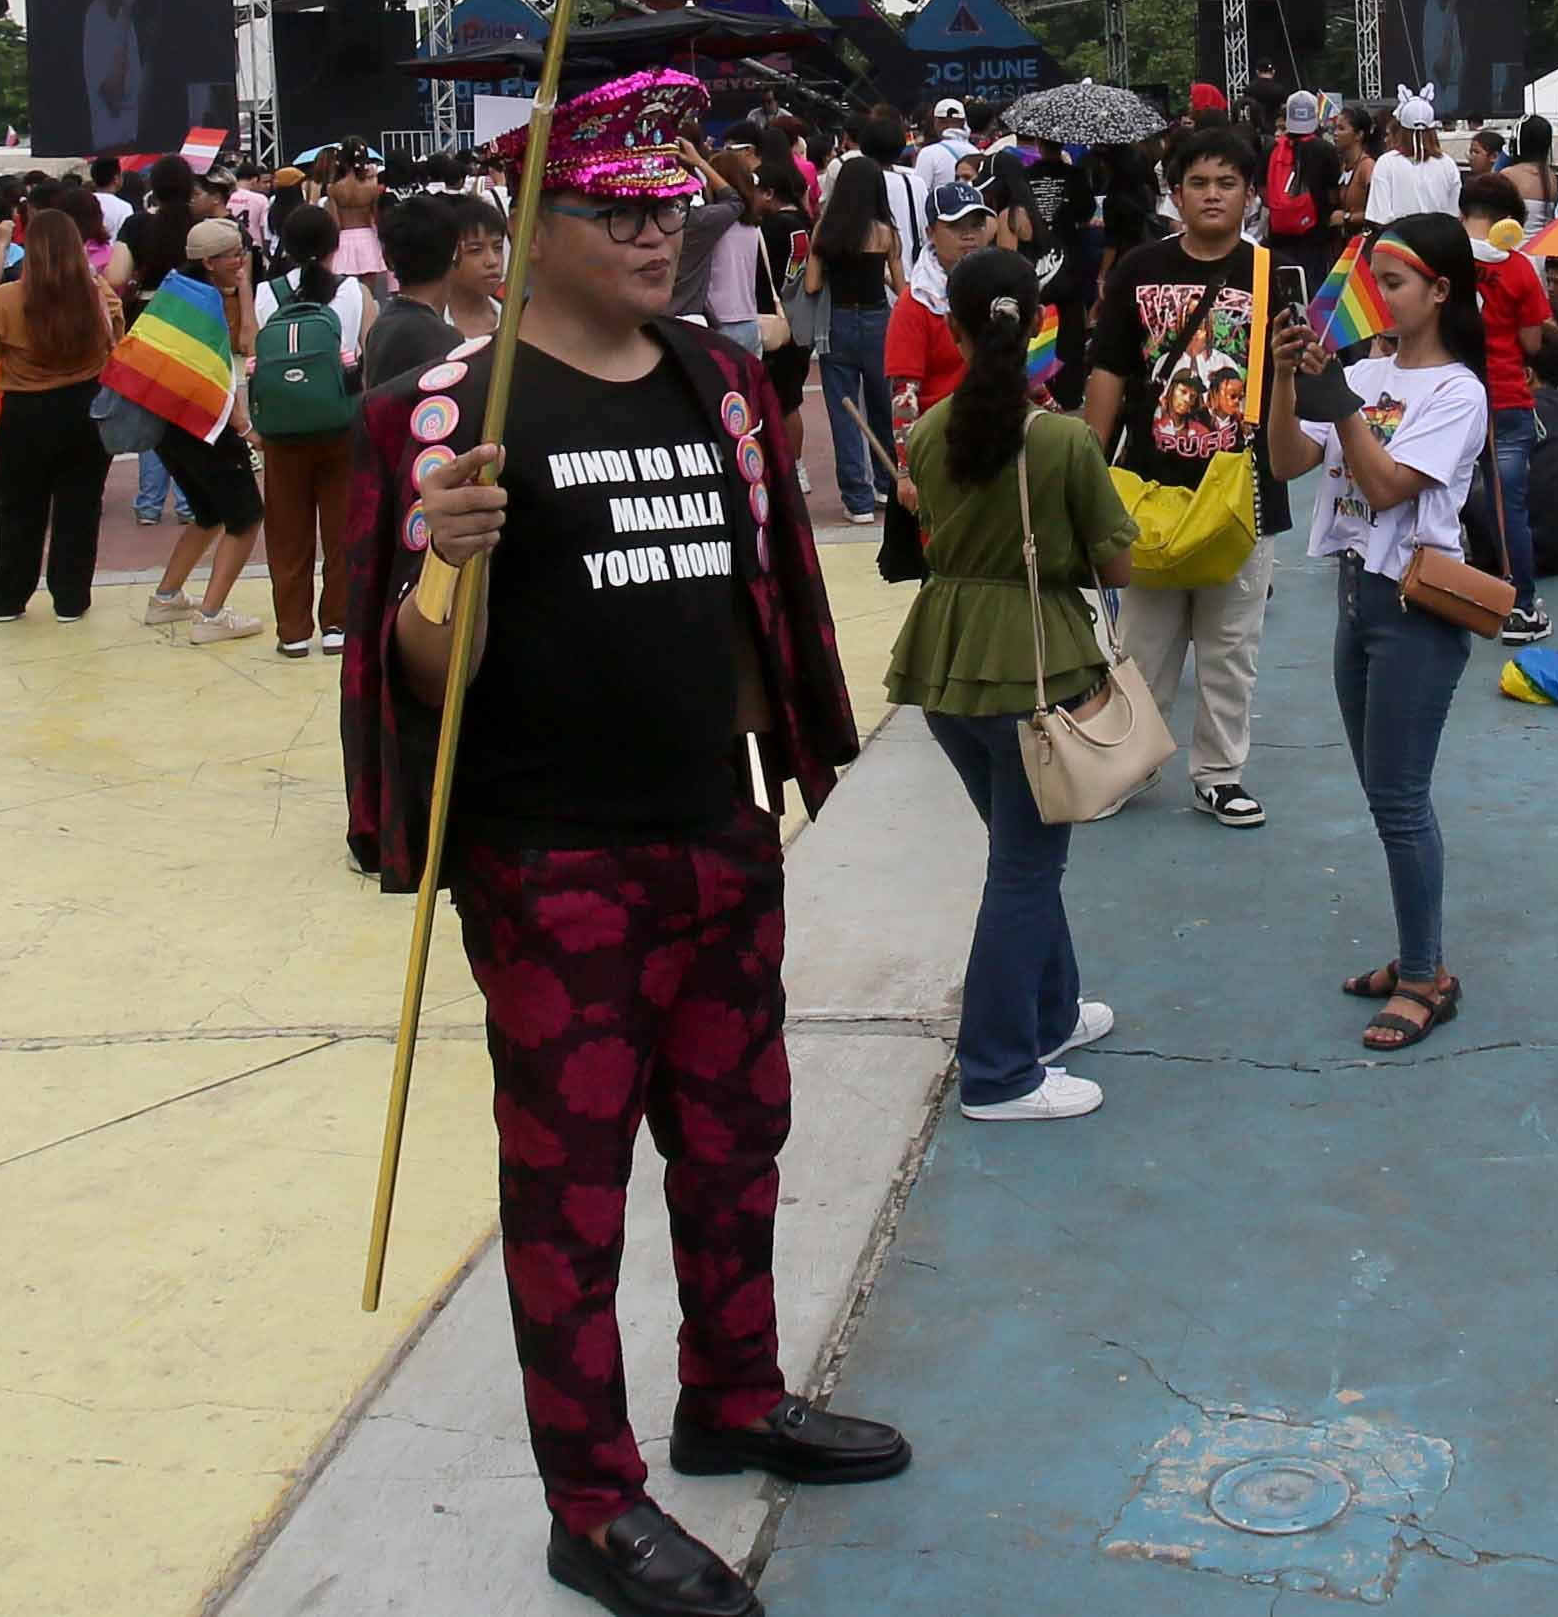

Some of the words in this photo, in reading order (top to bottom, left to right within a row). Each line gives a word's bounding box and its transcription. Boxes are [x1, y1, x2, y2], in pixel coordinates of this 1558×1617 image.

[973, 58, 1039, 79] JUNE
[548, 450, 636, 489] HINDI
[635, 447, 675, 481] KO
[674, 443, 715, 477] NA
[609, 491, 725, 533] MAALALA
[582, 546, 670, 589] YOUR
